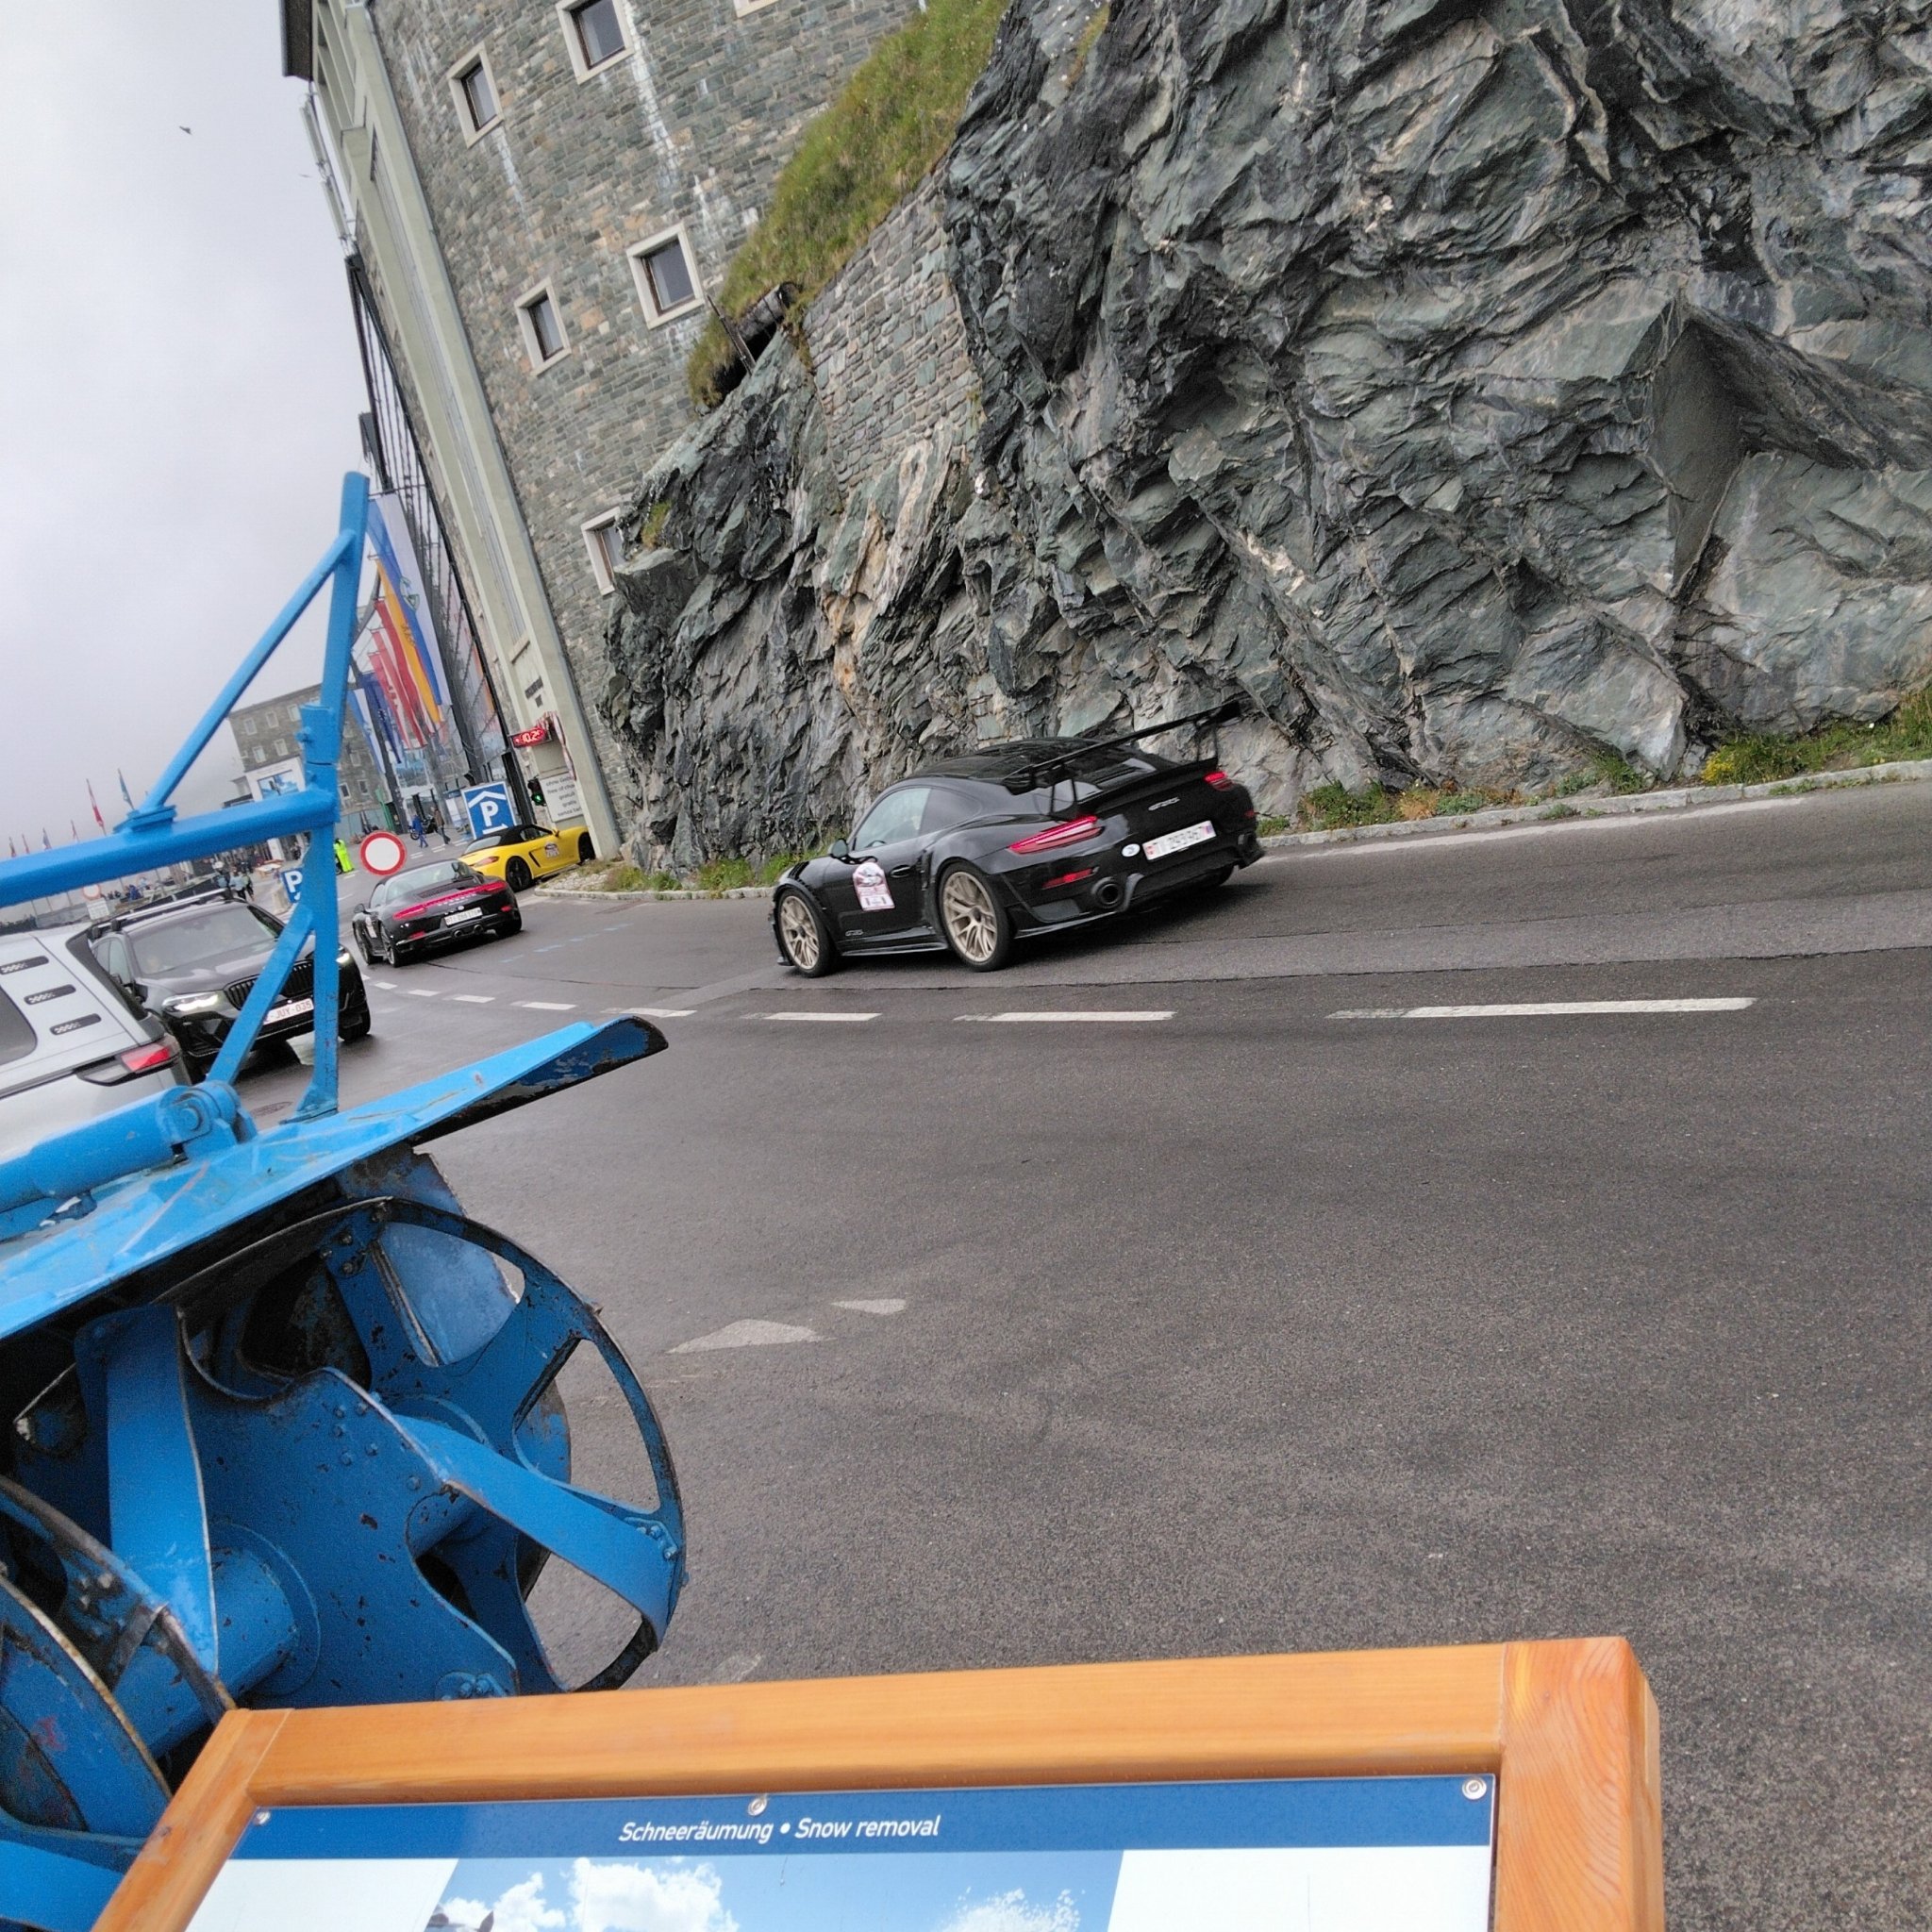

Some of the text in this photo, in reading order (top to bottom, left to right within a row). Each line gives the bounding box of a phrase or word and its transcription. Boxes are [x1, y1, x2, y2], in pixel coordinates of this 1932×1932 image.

[479, 800, 499, 827] P
[284, 870, 303, 893] P
[618, 1815, 941, 1844] Schneeräumung Snow removal
